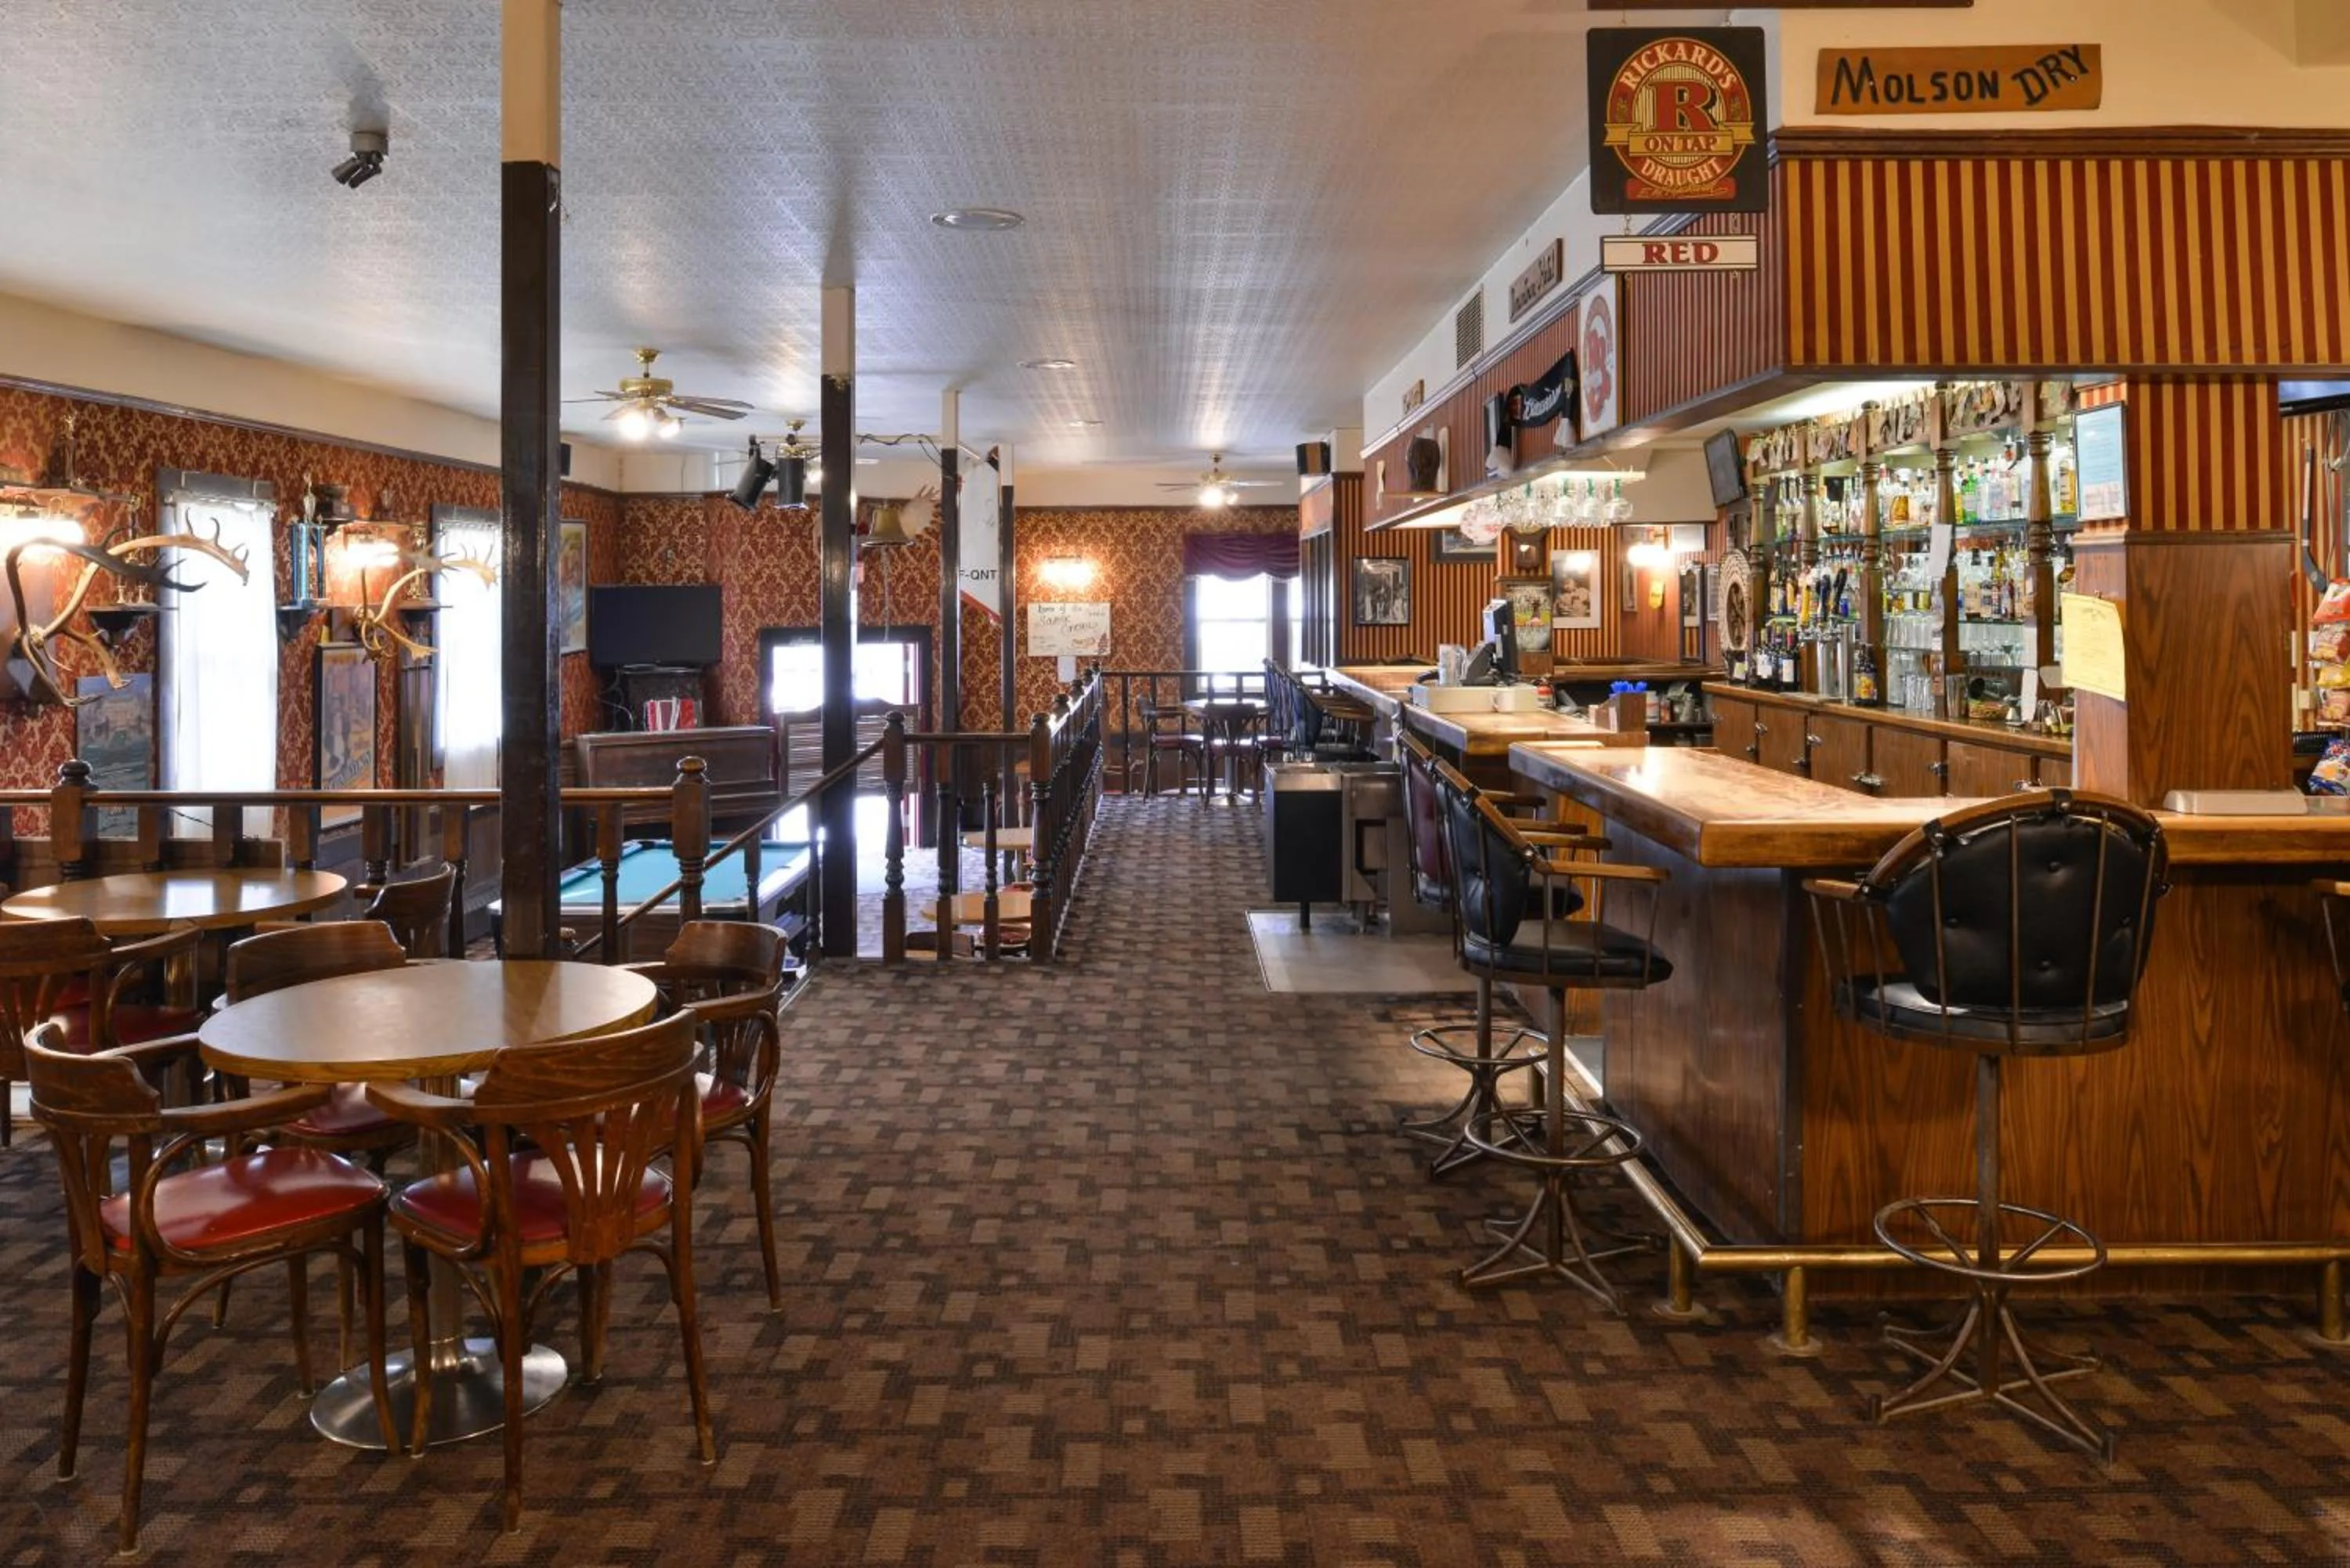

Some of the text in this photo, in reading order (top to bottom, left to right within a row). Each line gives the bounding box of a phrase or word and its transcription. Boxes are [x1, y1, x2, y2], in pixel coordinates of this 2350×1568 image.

[1619, 42, 1737, 89] RICKARD'S
[1831, 45, 2089, 107] MOLSON DRY
[1645, 80, 1719, 132] R
[1644, 135, 1719, 153] ON TAP
[1641, 156, 1723, 188] DRAUGHT
[1642, 241, 1719, 265] RED
